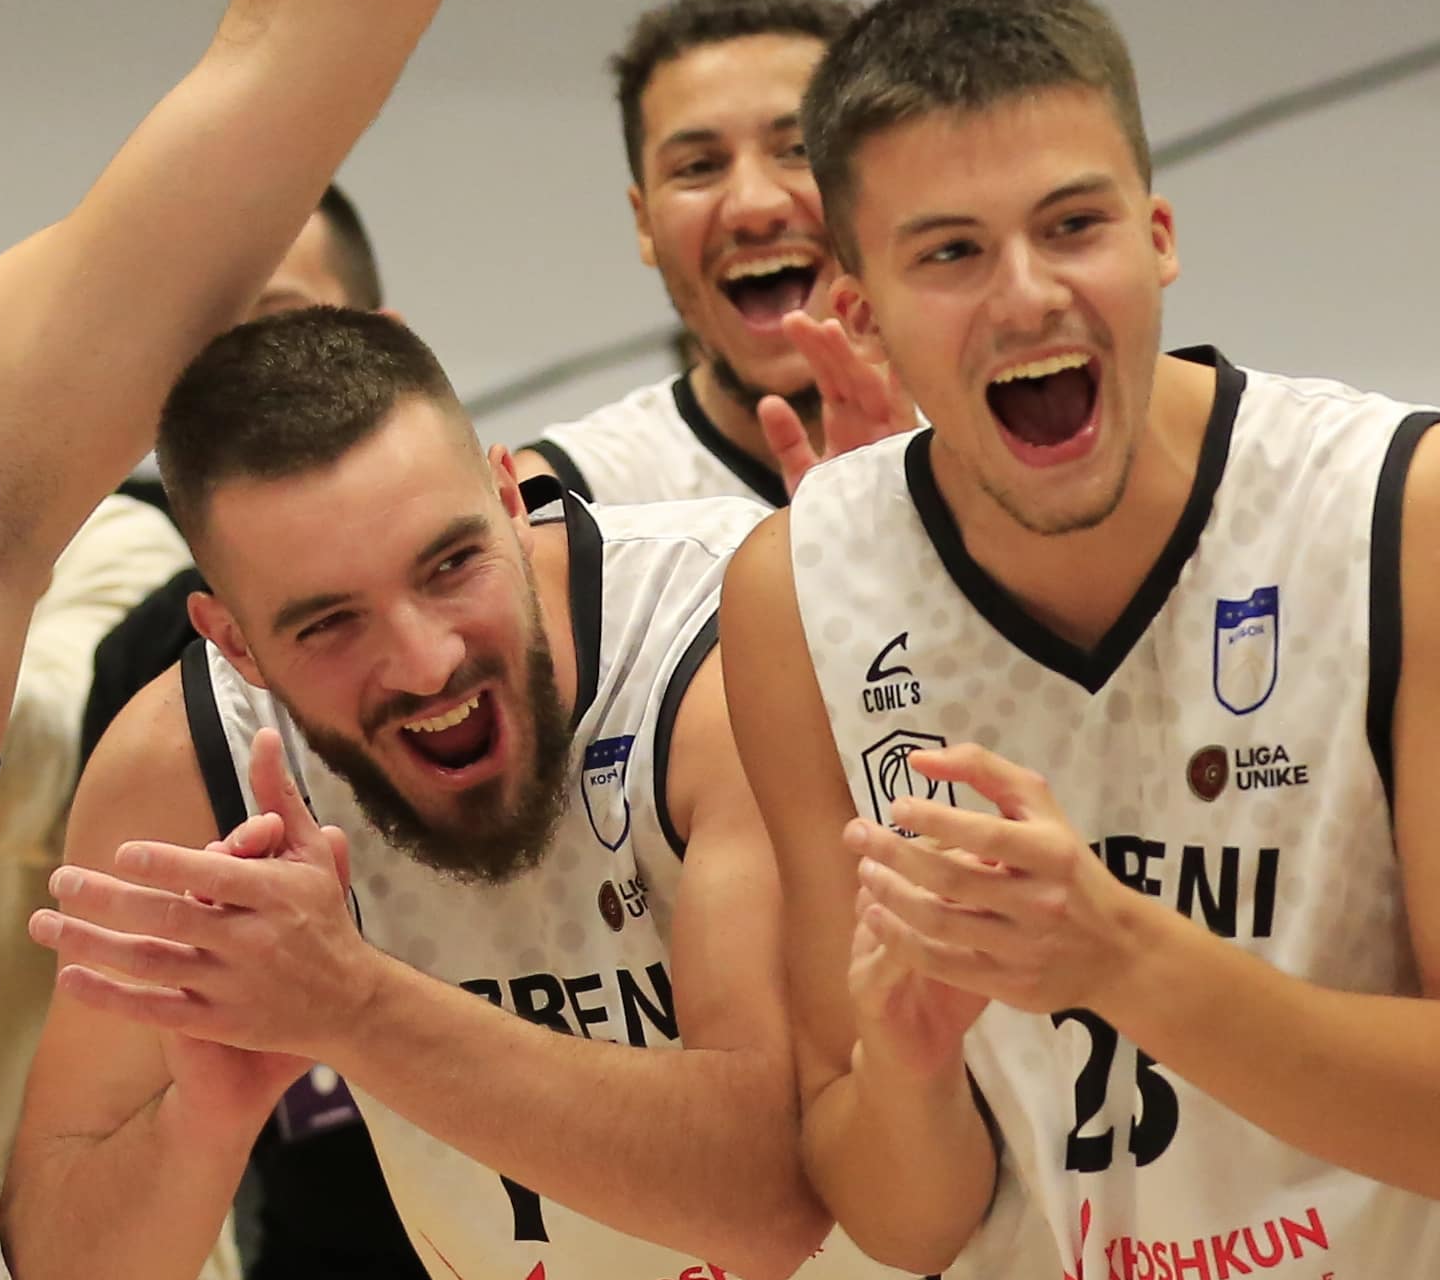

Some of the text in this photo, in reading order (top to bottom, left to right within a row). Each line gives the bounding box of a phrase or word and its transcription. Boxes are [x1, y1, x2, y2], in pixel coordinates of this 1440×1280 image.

[862, 681, 921, 714] COHL'S
[1234, 744, 1290, 768] LIGA
[1236, 765, 1309, 790] UNIKE
[1088, 834, 1281, 938] RENI
